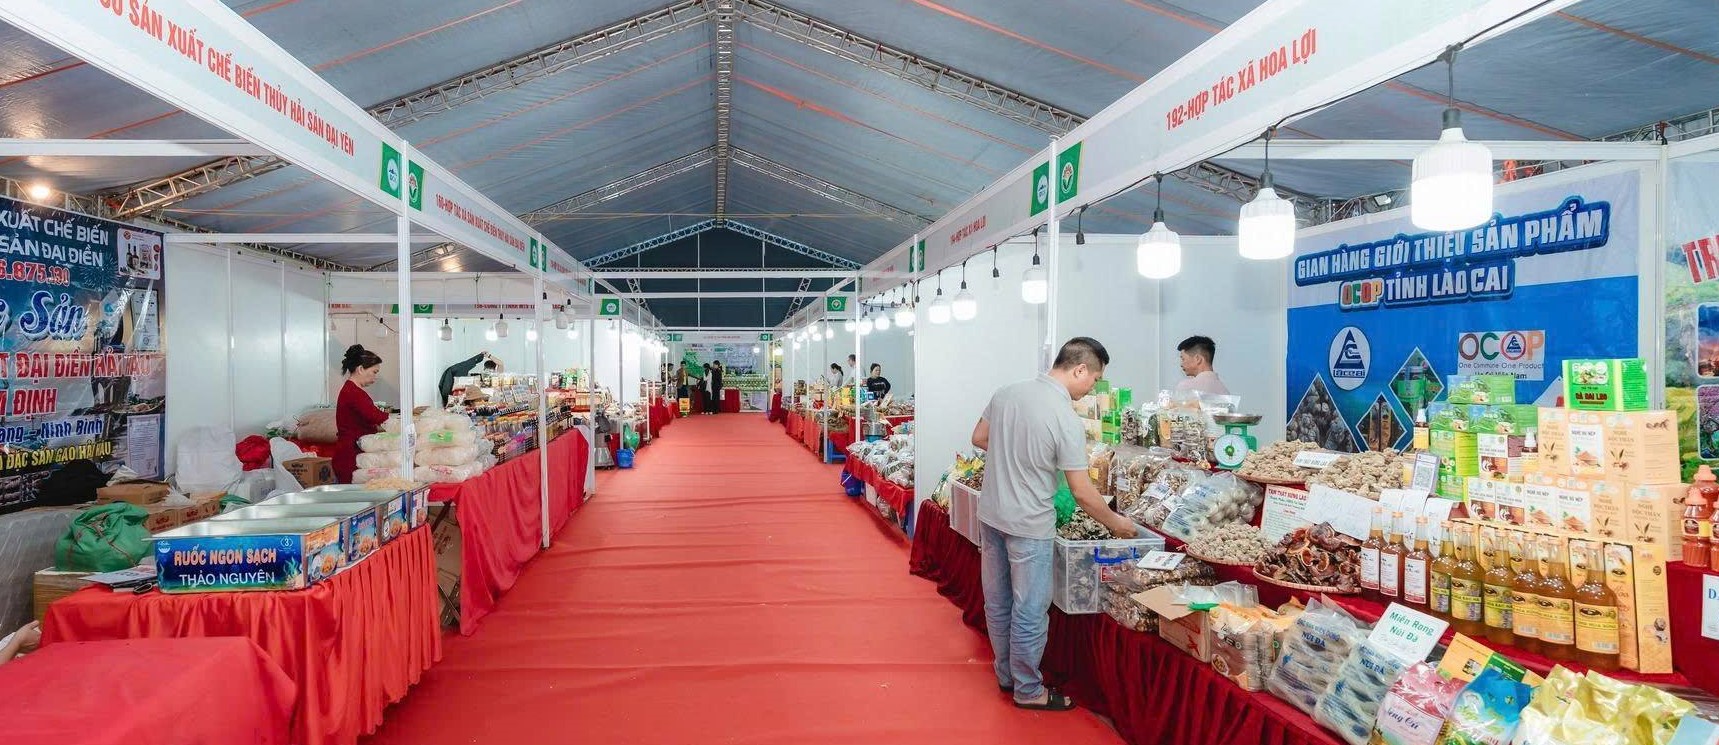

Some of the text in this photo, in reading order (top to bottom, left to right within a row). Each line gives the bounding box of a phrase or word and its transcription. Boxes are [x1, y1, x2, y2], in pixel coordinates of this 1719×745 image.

[168, 20, 203, 64] XUẤT
[207, 47, 231, 82] CHẾ
[235, 64, 260, 100] BIẾN
[1166, 28, 1316, 130] 192-HỢP TÁC XÃ HOA LỢI
[44, 218, 75, 239] CHẾ
[77, 224, 109, 245] BIẾN
[1298, 256, 1328, 279] GIAN
[1332, 250, 1370, 273] HÀNG
[1375, 239, 1410, 267] GIỚI
[1472, 219, 1518, 253] SẢN
[1525, 203, 1602, 246] PHẨM
[1682, 233, 1719, 283] TR
[1342, 266, 1508, 304] OCOP TỈNH LÀO CAI
[1459, 331, 1544, 360] OCOP
[16, 352, 49, 383] ĐẠI
[13, 389, 58, 420] ĐỊNH
[41, 422, 72, 438] Ninh
[174, 544, 276, 566] RUỐC NGON SẠCH
[179, 569, 275, 586] THẢO NGUYÊN
